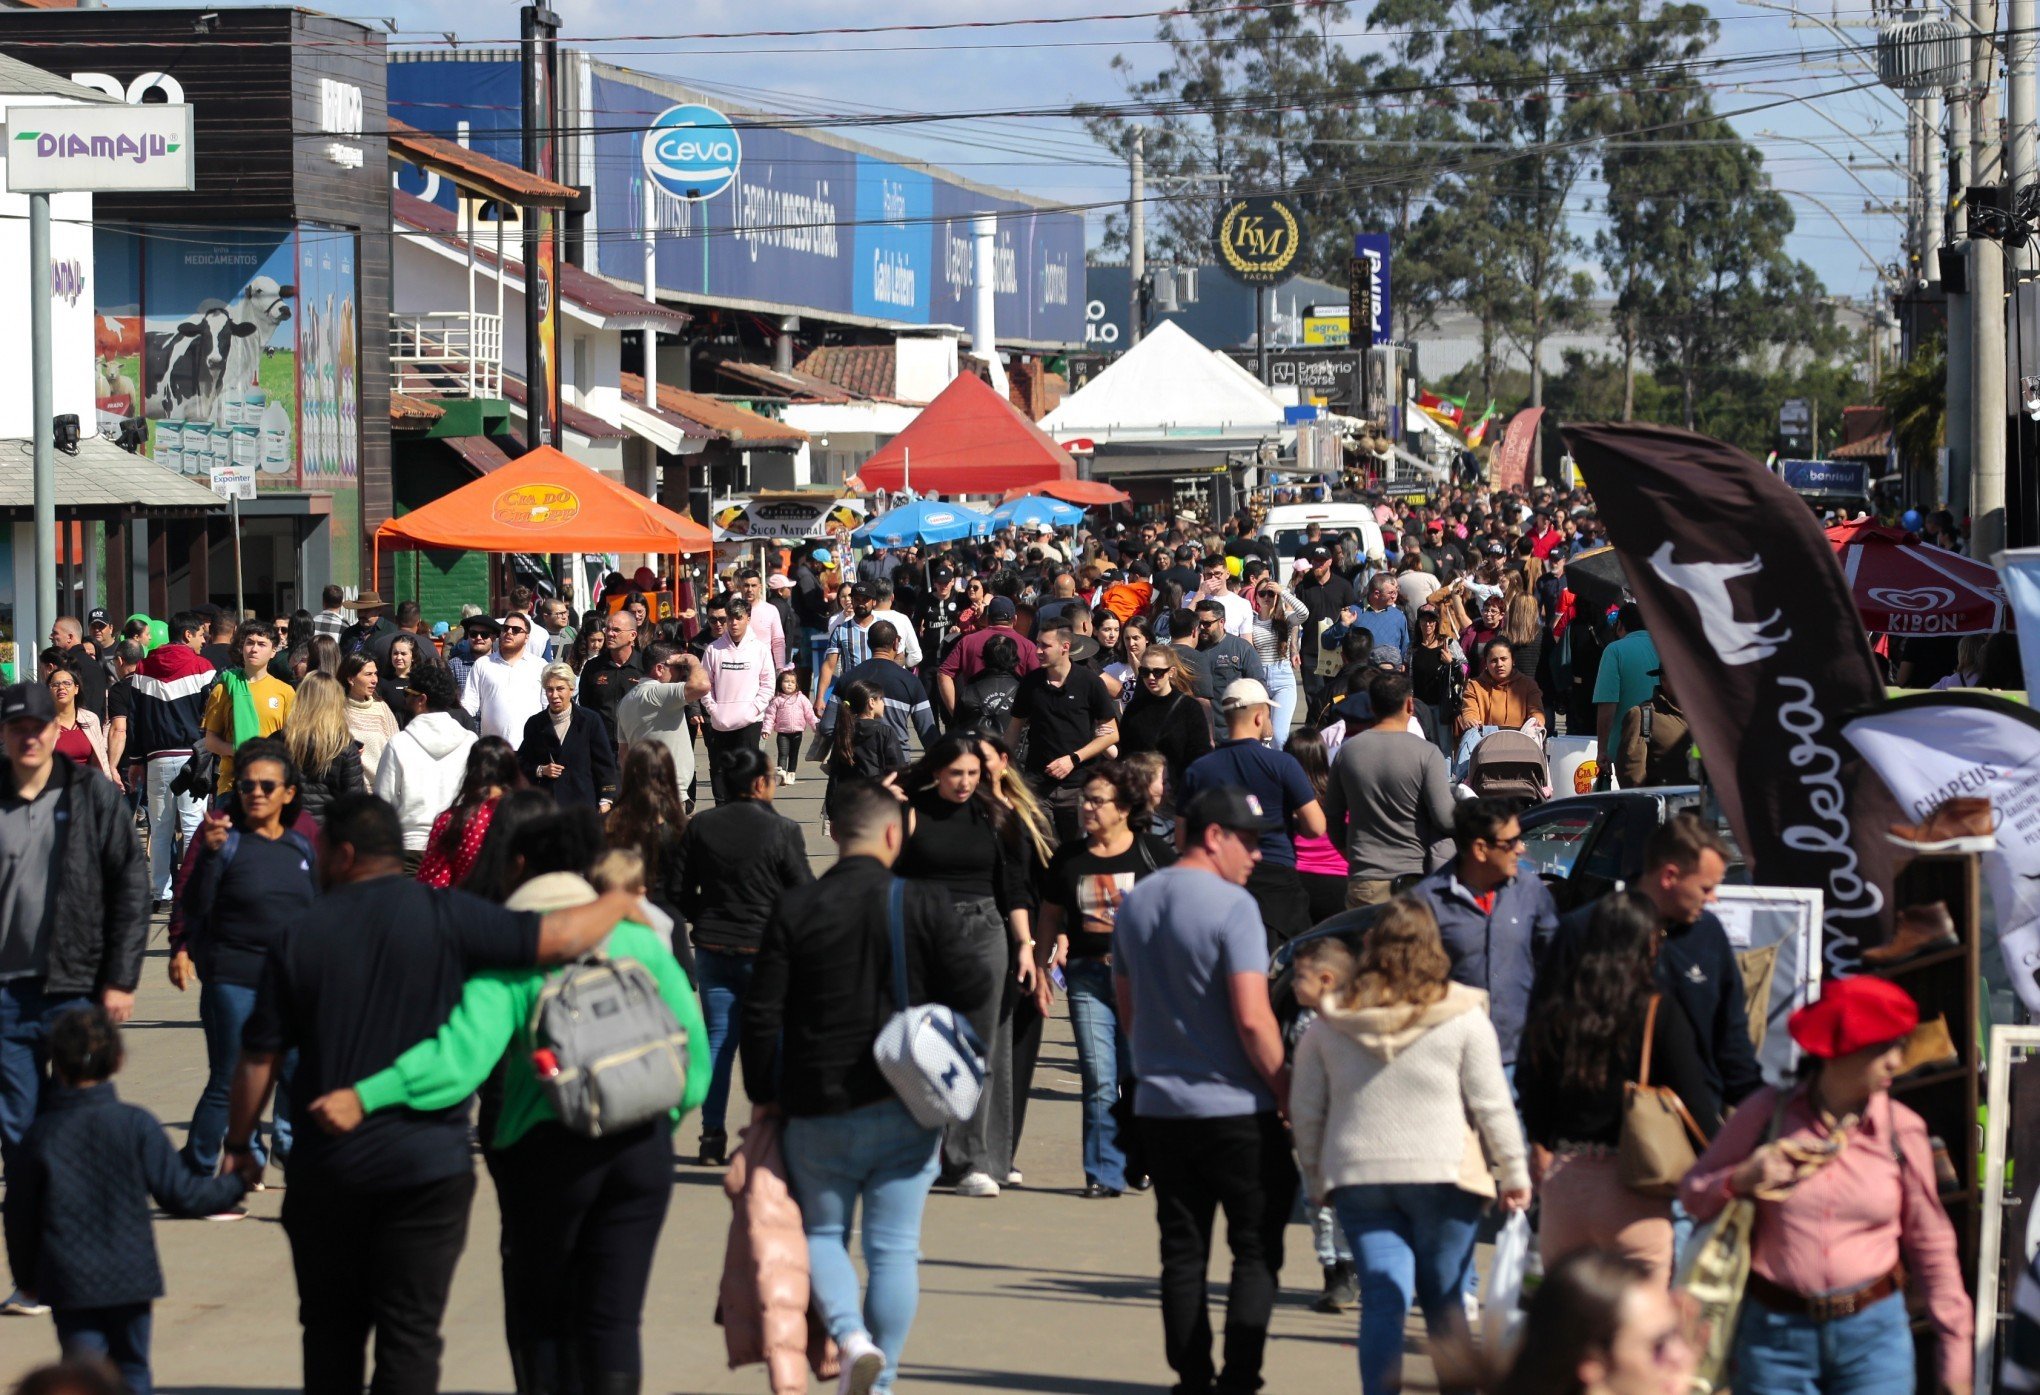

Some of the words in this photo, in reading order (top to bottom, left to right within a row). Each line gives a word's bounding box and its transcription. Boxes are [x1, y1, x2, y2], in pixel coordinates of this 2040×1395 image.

[37, 132, 166, 164] DIAMAJU
[782, 192, 812, 253] nosso
[1235, 216, 1284, 256] KM
[184, 255, 258, 265] MEDICAMENTOS
[213, 475, 251, 483] Expointer
[1888, 613, 1957, 632] KIBON
